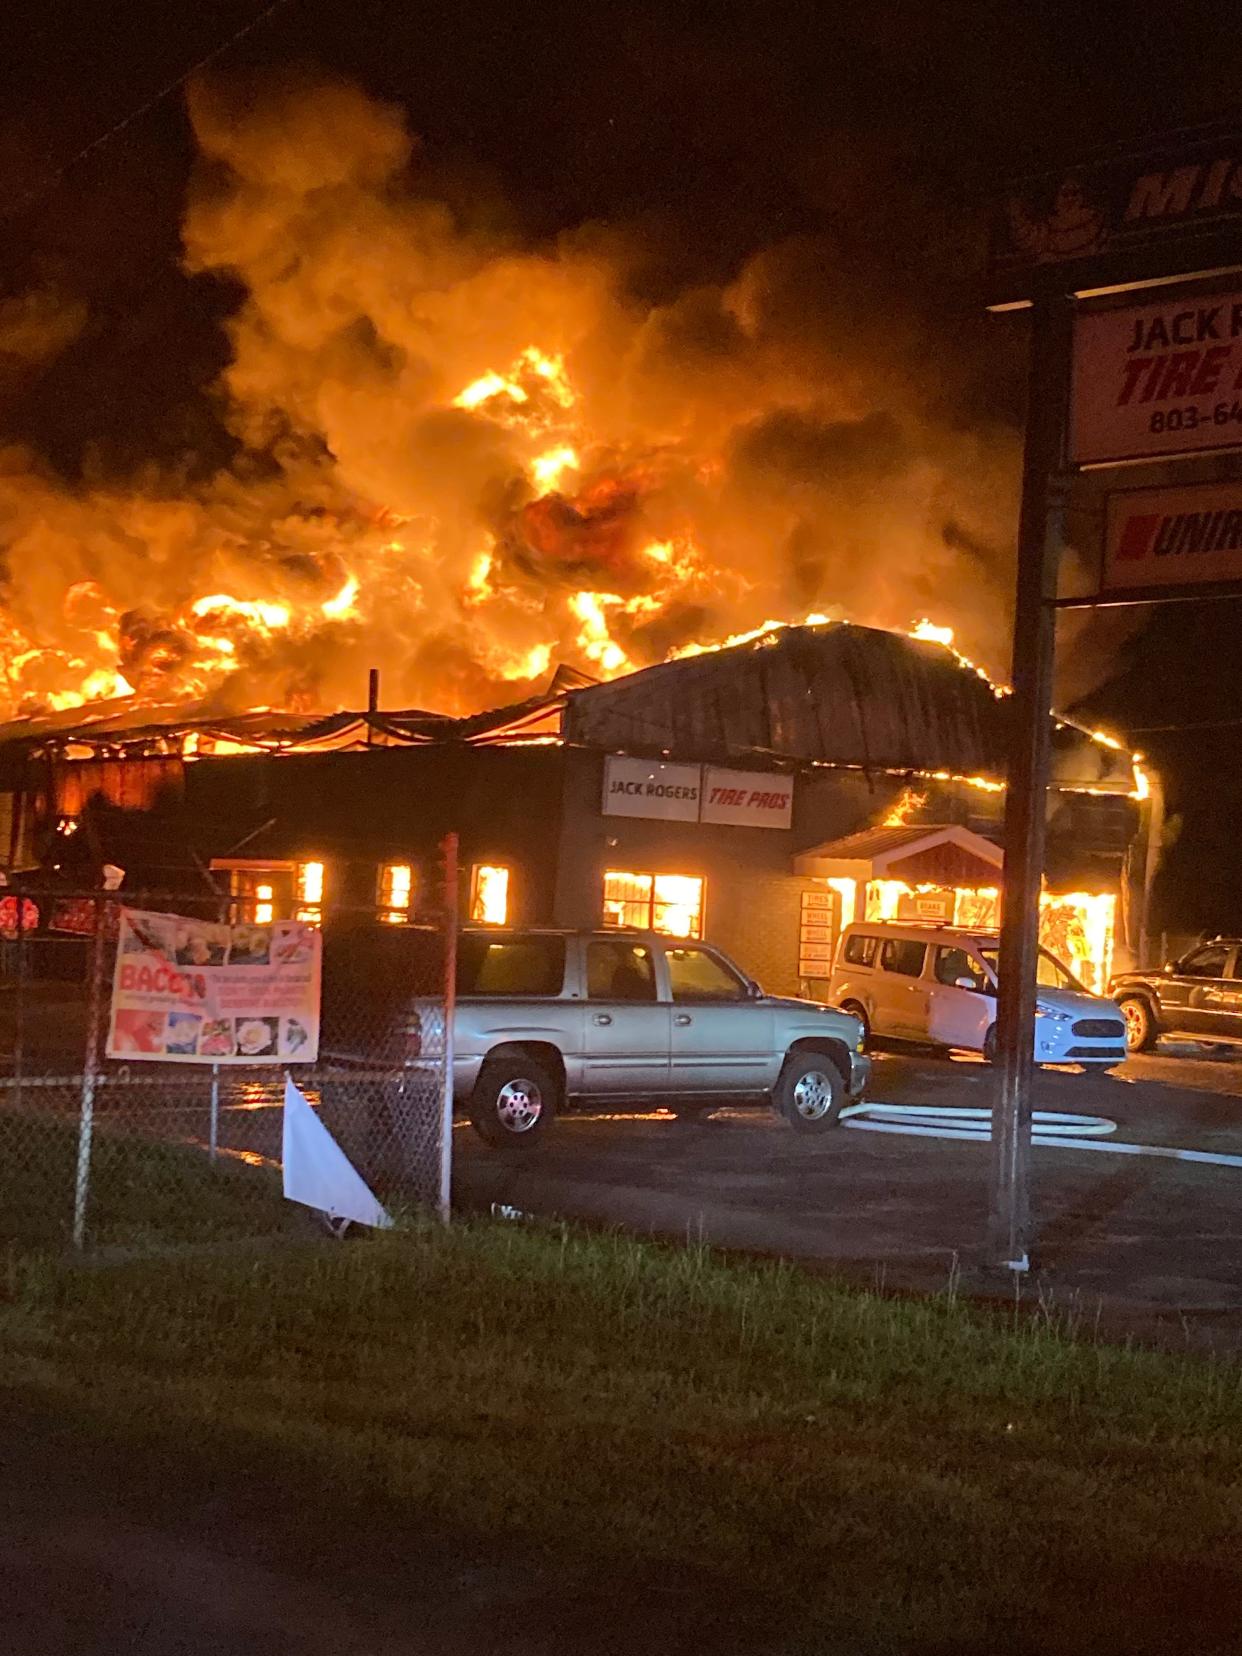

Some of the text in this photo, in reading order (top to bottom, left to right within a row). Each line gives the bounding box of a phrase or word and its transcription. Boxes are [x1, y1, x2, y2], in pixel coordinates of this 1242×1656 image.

[1127, 305, 1223, 353] JACK
[1116, 345, 1234, 407] TIRE
[610, 780, 698, 801] JACK ROGERS
[708, 787, 790, 810] TIRE PROS
